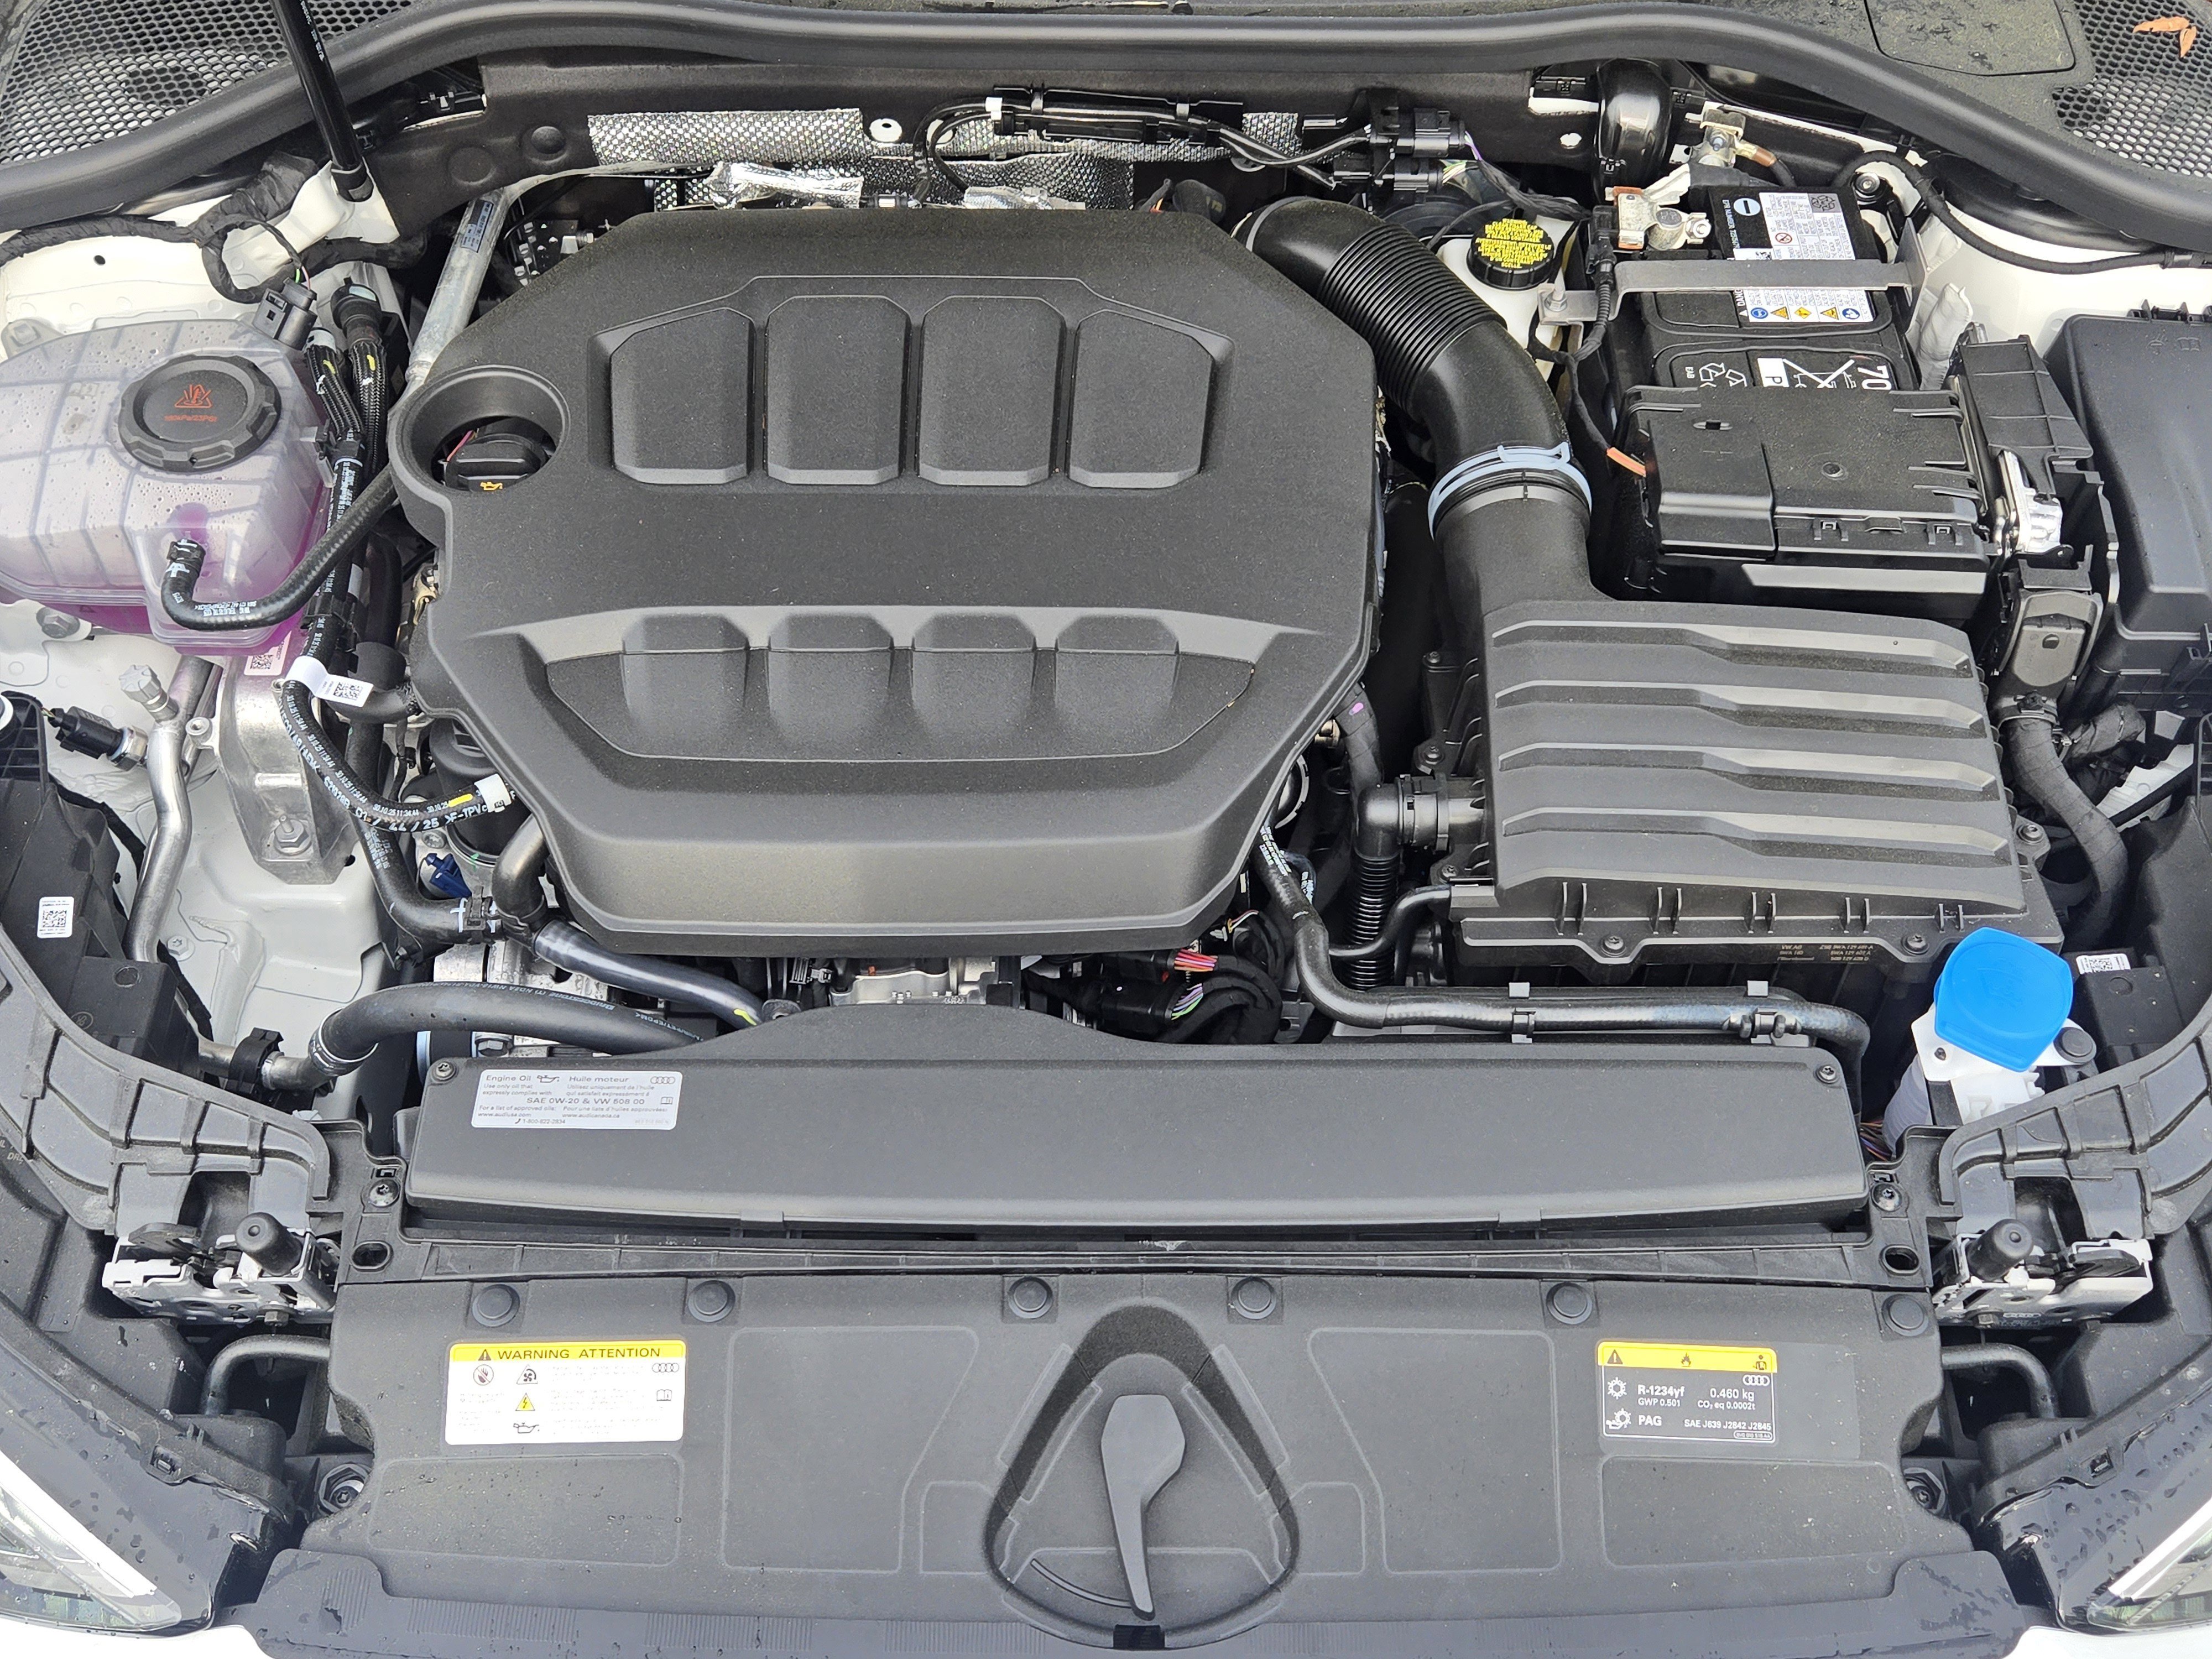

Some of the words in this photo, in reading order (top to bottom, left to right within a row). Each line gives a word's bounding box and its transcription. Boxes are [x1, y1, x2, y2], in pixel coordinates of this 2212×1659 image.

[486, 1074, 516, 1083] Engine
[498, 1349, 570, 1360] WARNING
[578, 1348, 661, 1358] ATTENTION
[1637, 1384, 1685, 1397] R-1234yf
[1710, 1388, 1739, 1399] 0.460
[1742, 1389, 1755, 1402] kg
[1637, 1398, 1658, 1407] GWP
[1660, 1399, 1681, 1407] 0.501
[1638, 1415, 1662, 1426] PAG
[1684, 1419, 1702, 1428] SAE
